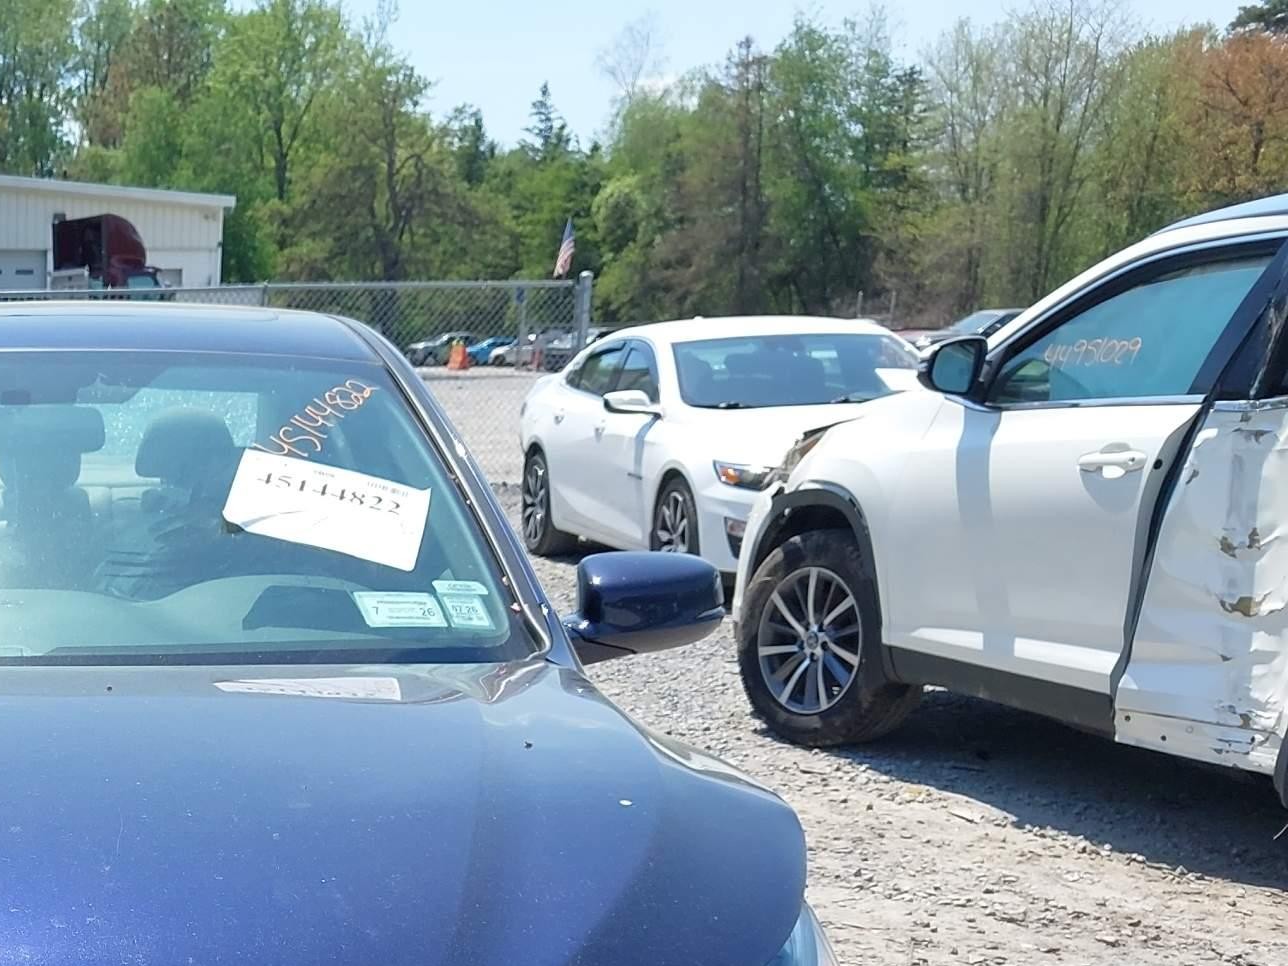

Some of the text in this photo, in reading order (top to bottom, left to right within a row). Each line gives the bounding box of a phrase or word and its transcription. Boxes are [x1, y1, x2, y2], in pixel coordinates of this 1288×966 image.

[1044, 336, 1142, 369] 44951029
[252, 380, 380, 456] 45144822
[257, 472, 401, 516] 45144822
[419, 607, 436, 617] 26
